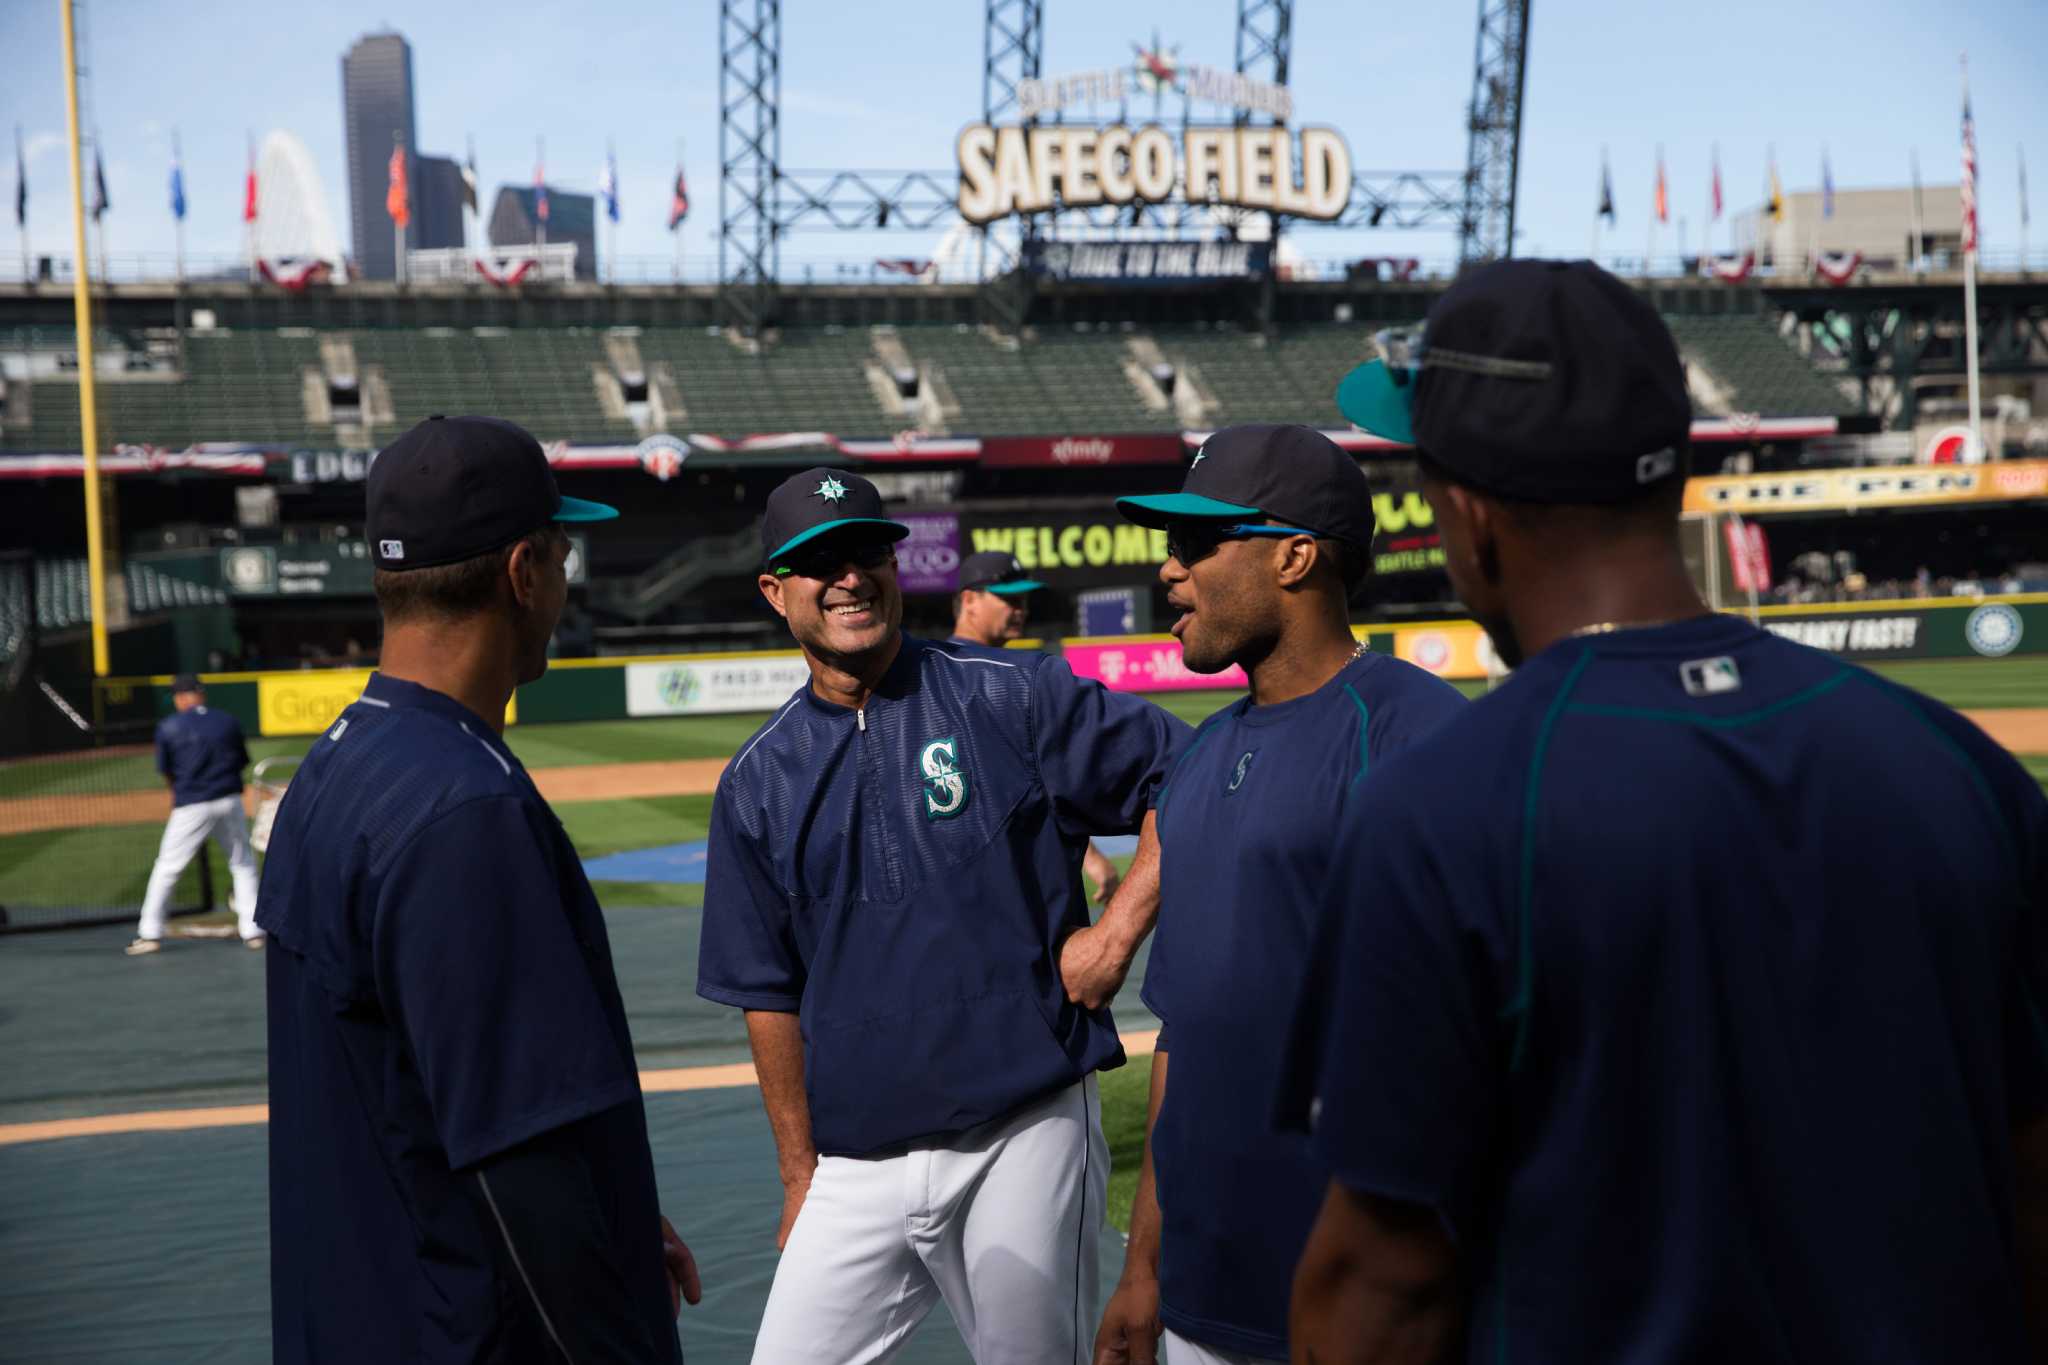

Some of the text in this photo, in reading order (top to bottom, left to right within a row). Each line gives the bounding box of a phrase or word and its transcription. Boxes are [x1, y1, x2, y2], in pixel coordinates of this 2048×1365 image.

[957, 122, 1352, 222] SAFECO FIELD
[292, 449, 380, 483] EDG
[1051, 437, 1115, 464] xfinity
[971, 524, 1169, 569] WELCOME
[711, 668, 763, 687] FRED
